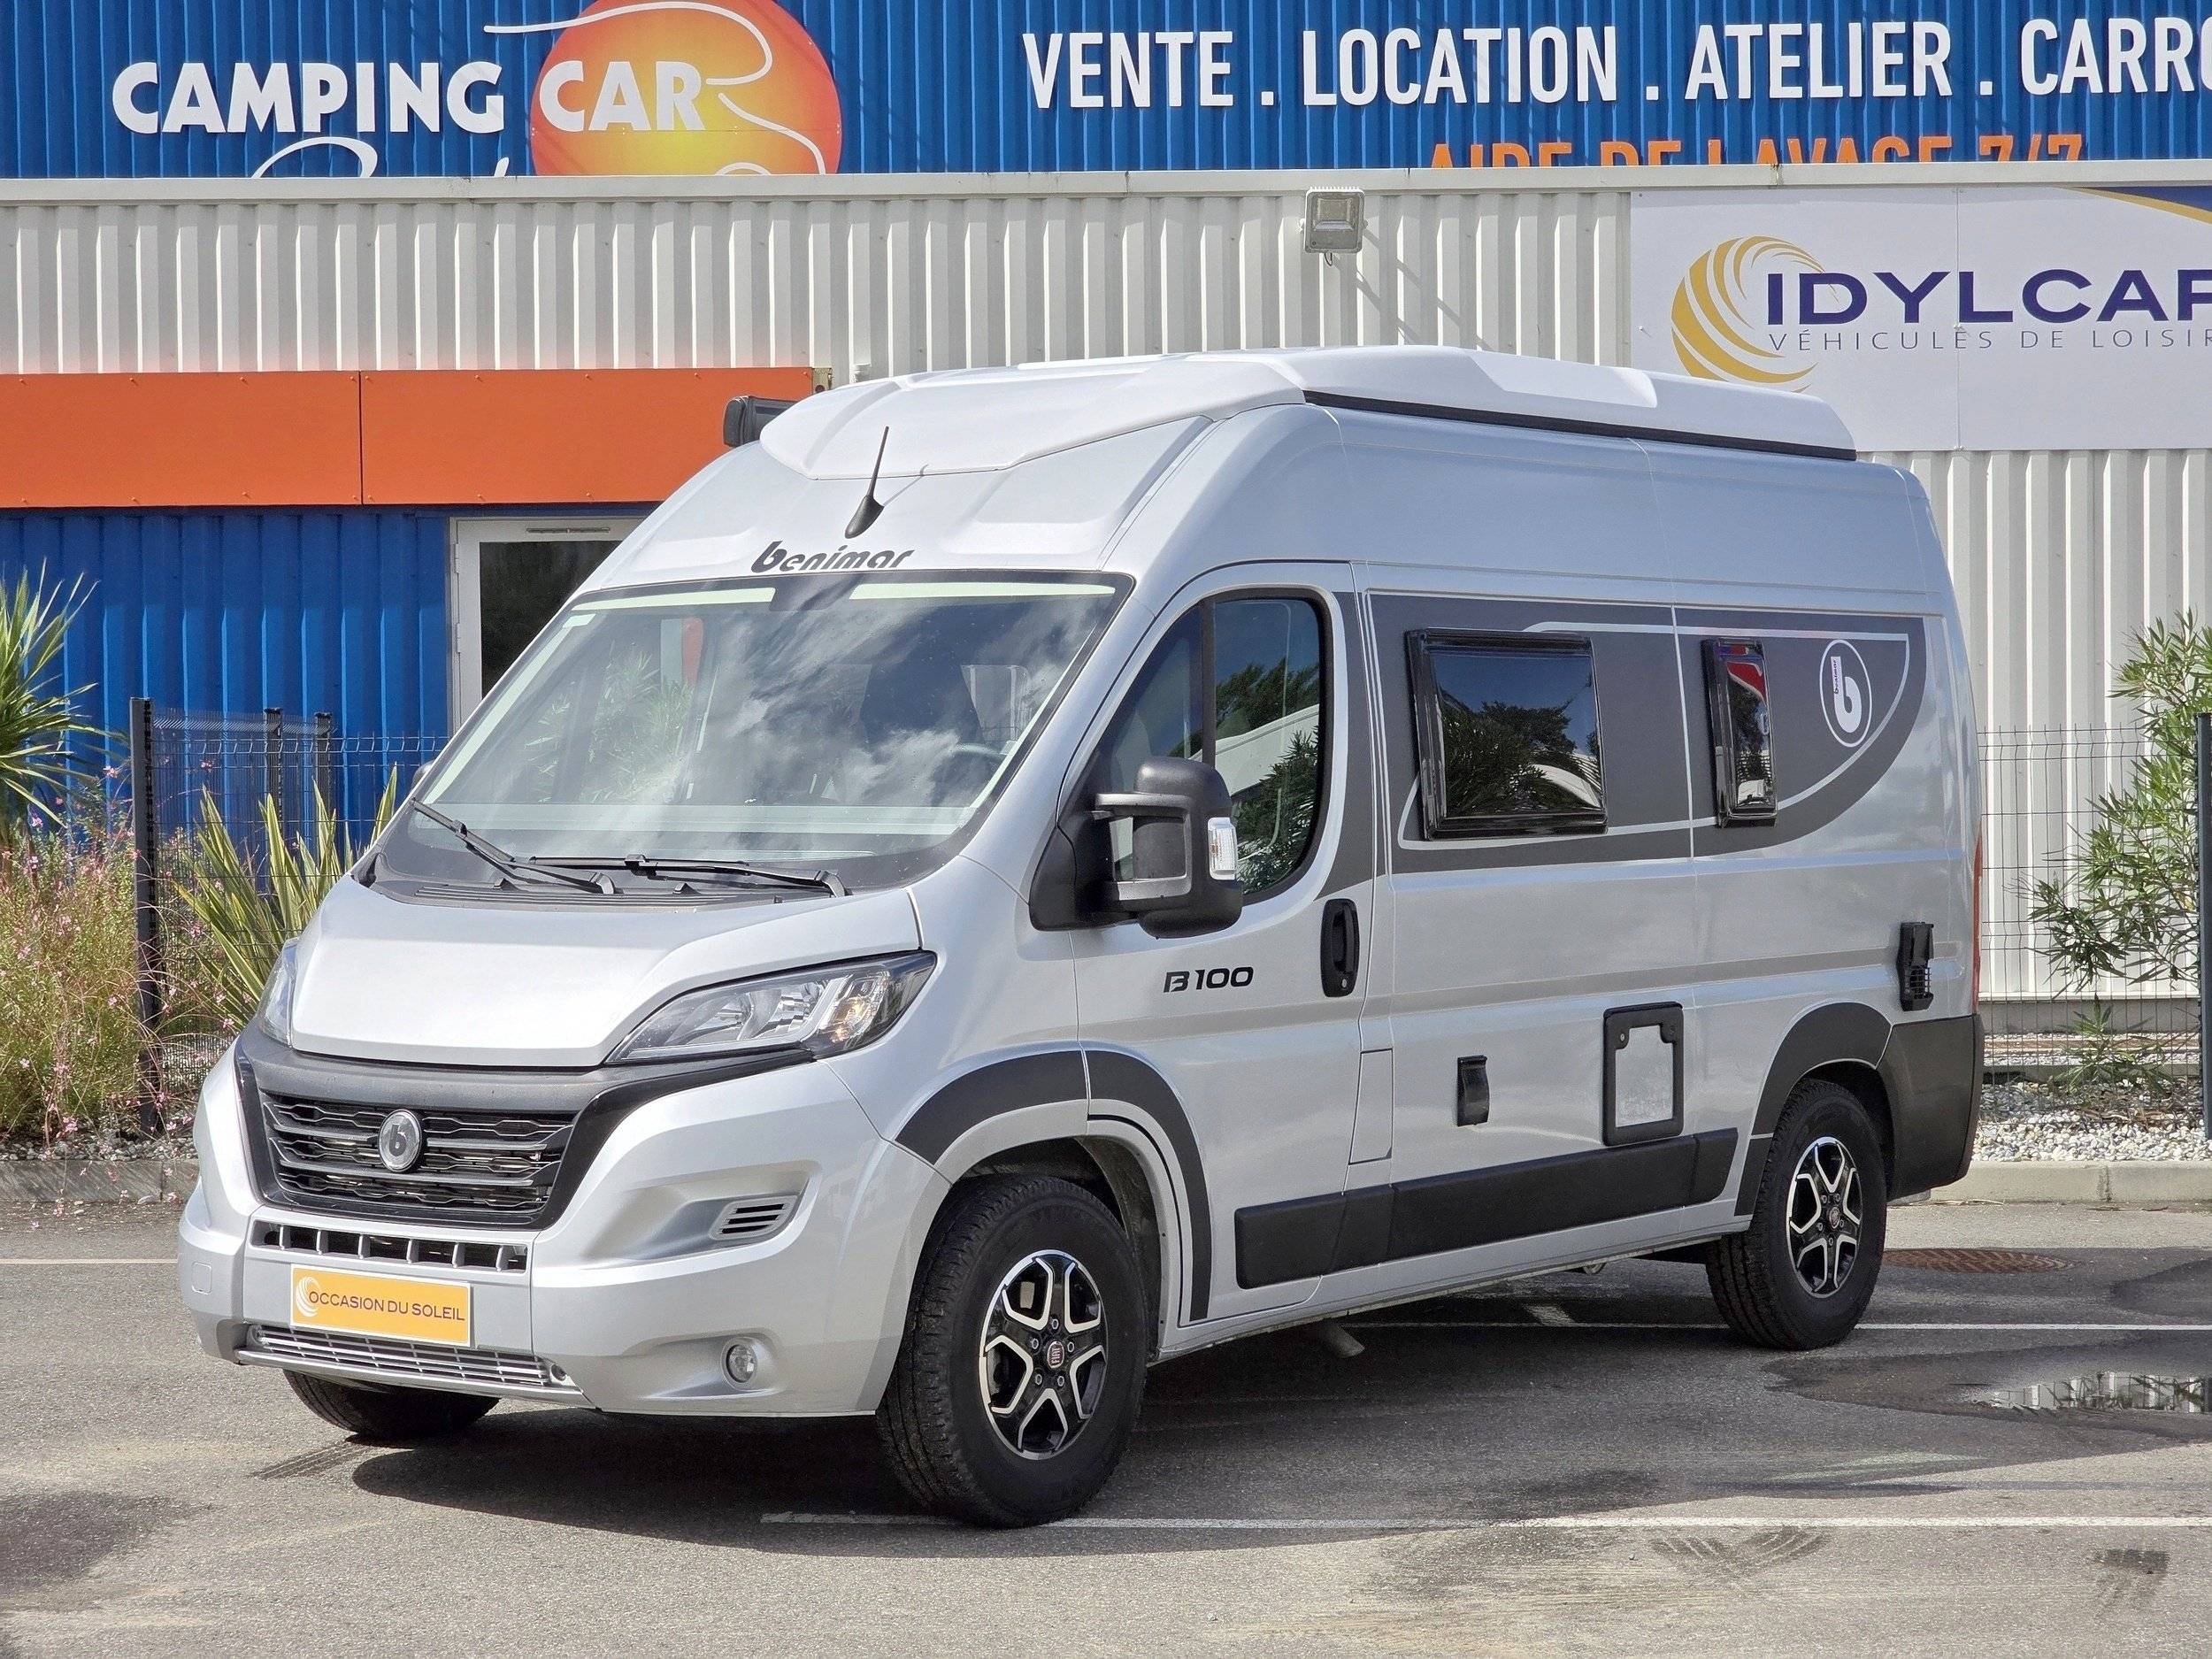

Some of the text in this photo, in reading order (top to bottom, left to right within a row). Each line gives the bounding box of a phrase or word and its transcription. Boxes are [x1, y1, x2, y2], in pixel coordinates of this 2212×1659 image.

[1022, 30, 1234, 109] VENTE
[1303, 26, 1617, 106] LOCATION
[1685, 21, 1954, 100] ATELIER
[2021, 17, 2212, 96] CARR
[111, 59, 707, 134] CAMPING CAR
[1770, 327, 1993, 352] VÉHICULES
[2020, 329, 2063, 349] DE
[751, 540, 915, 573] benimar
[1163, 966, 1255, 994] B100
[309, 1290, 465, 1321] OCCASION DU SOLEIL
